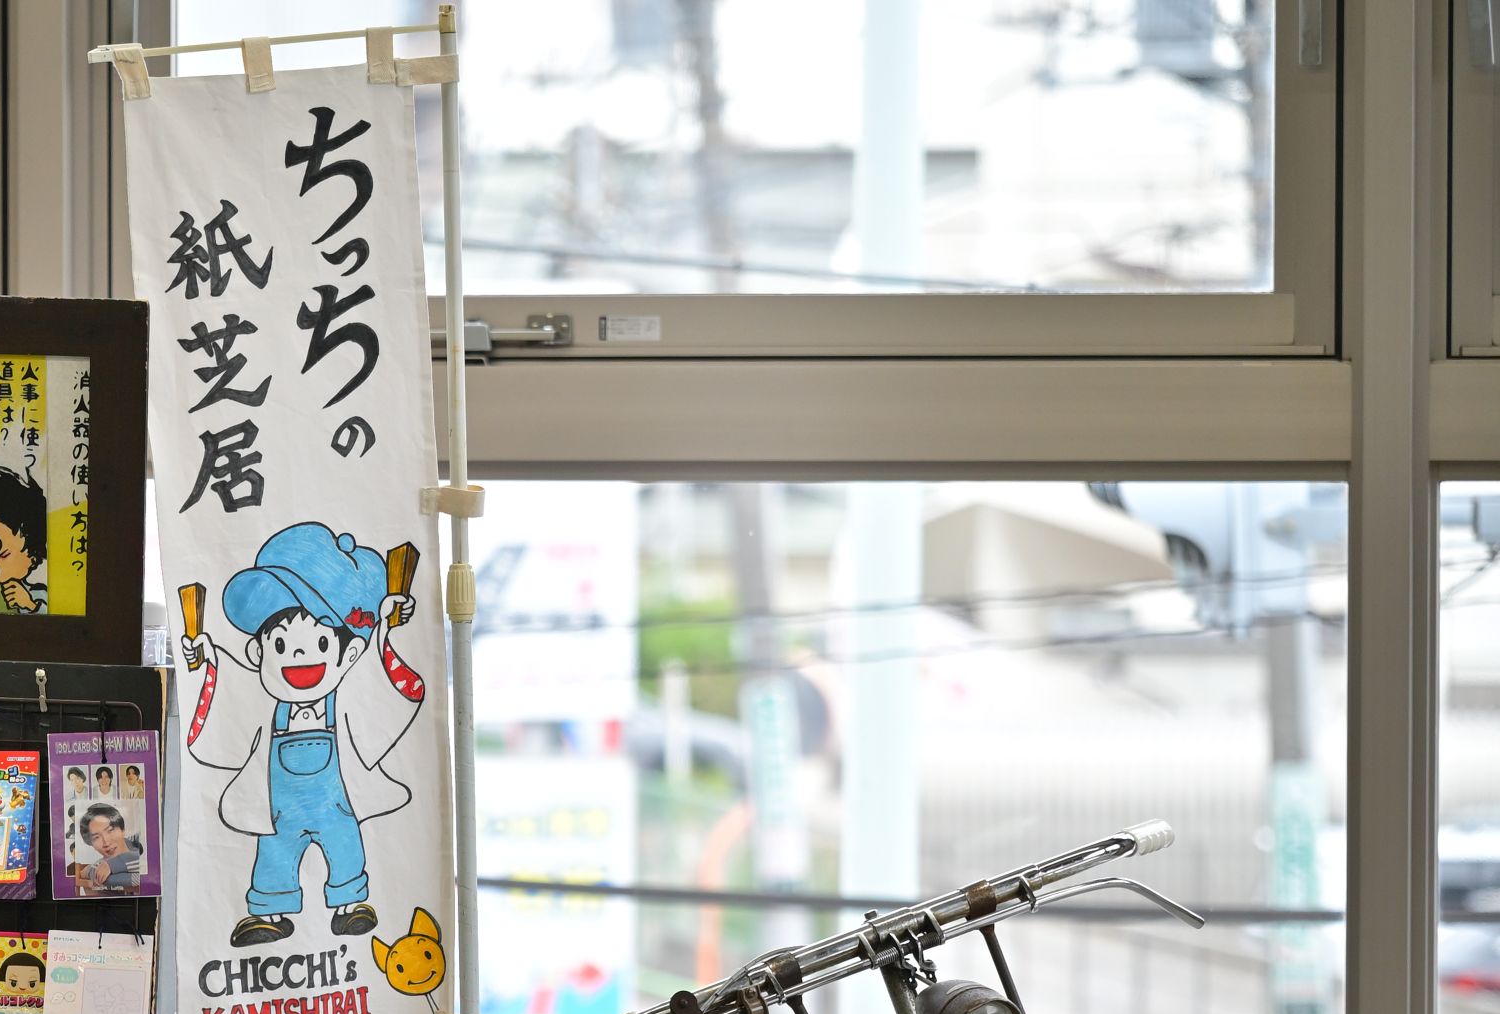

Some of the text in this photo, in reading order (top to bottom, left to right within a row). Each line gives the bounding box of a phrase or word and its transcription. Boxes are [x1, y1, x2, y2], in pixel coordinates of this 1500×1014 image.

[285, 106, 380, 458] ちっちの
[165, 199, 274, 514] 紙芝居
[20, 362, 40, 468] 火事に使う
[126, 735, 149, 752] MAN
[199, 944, 358, 997] CHICCHI's
